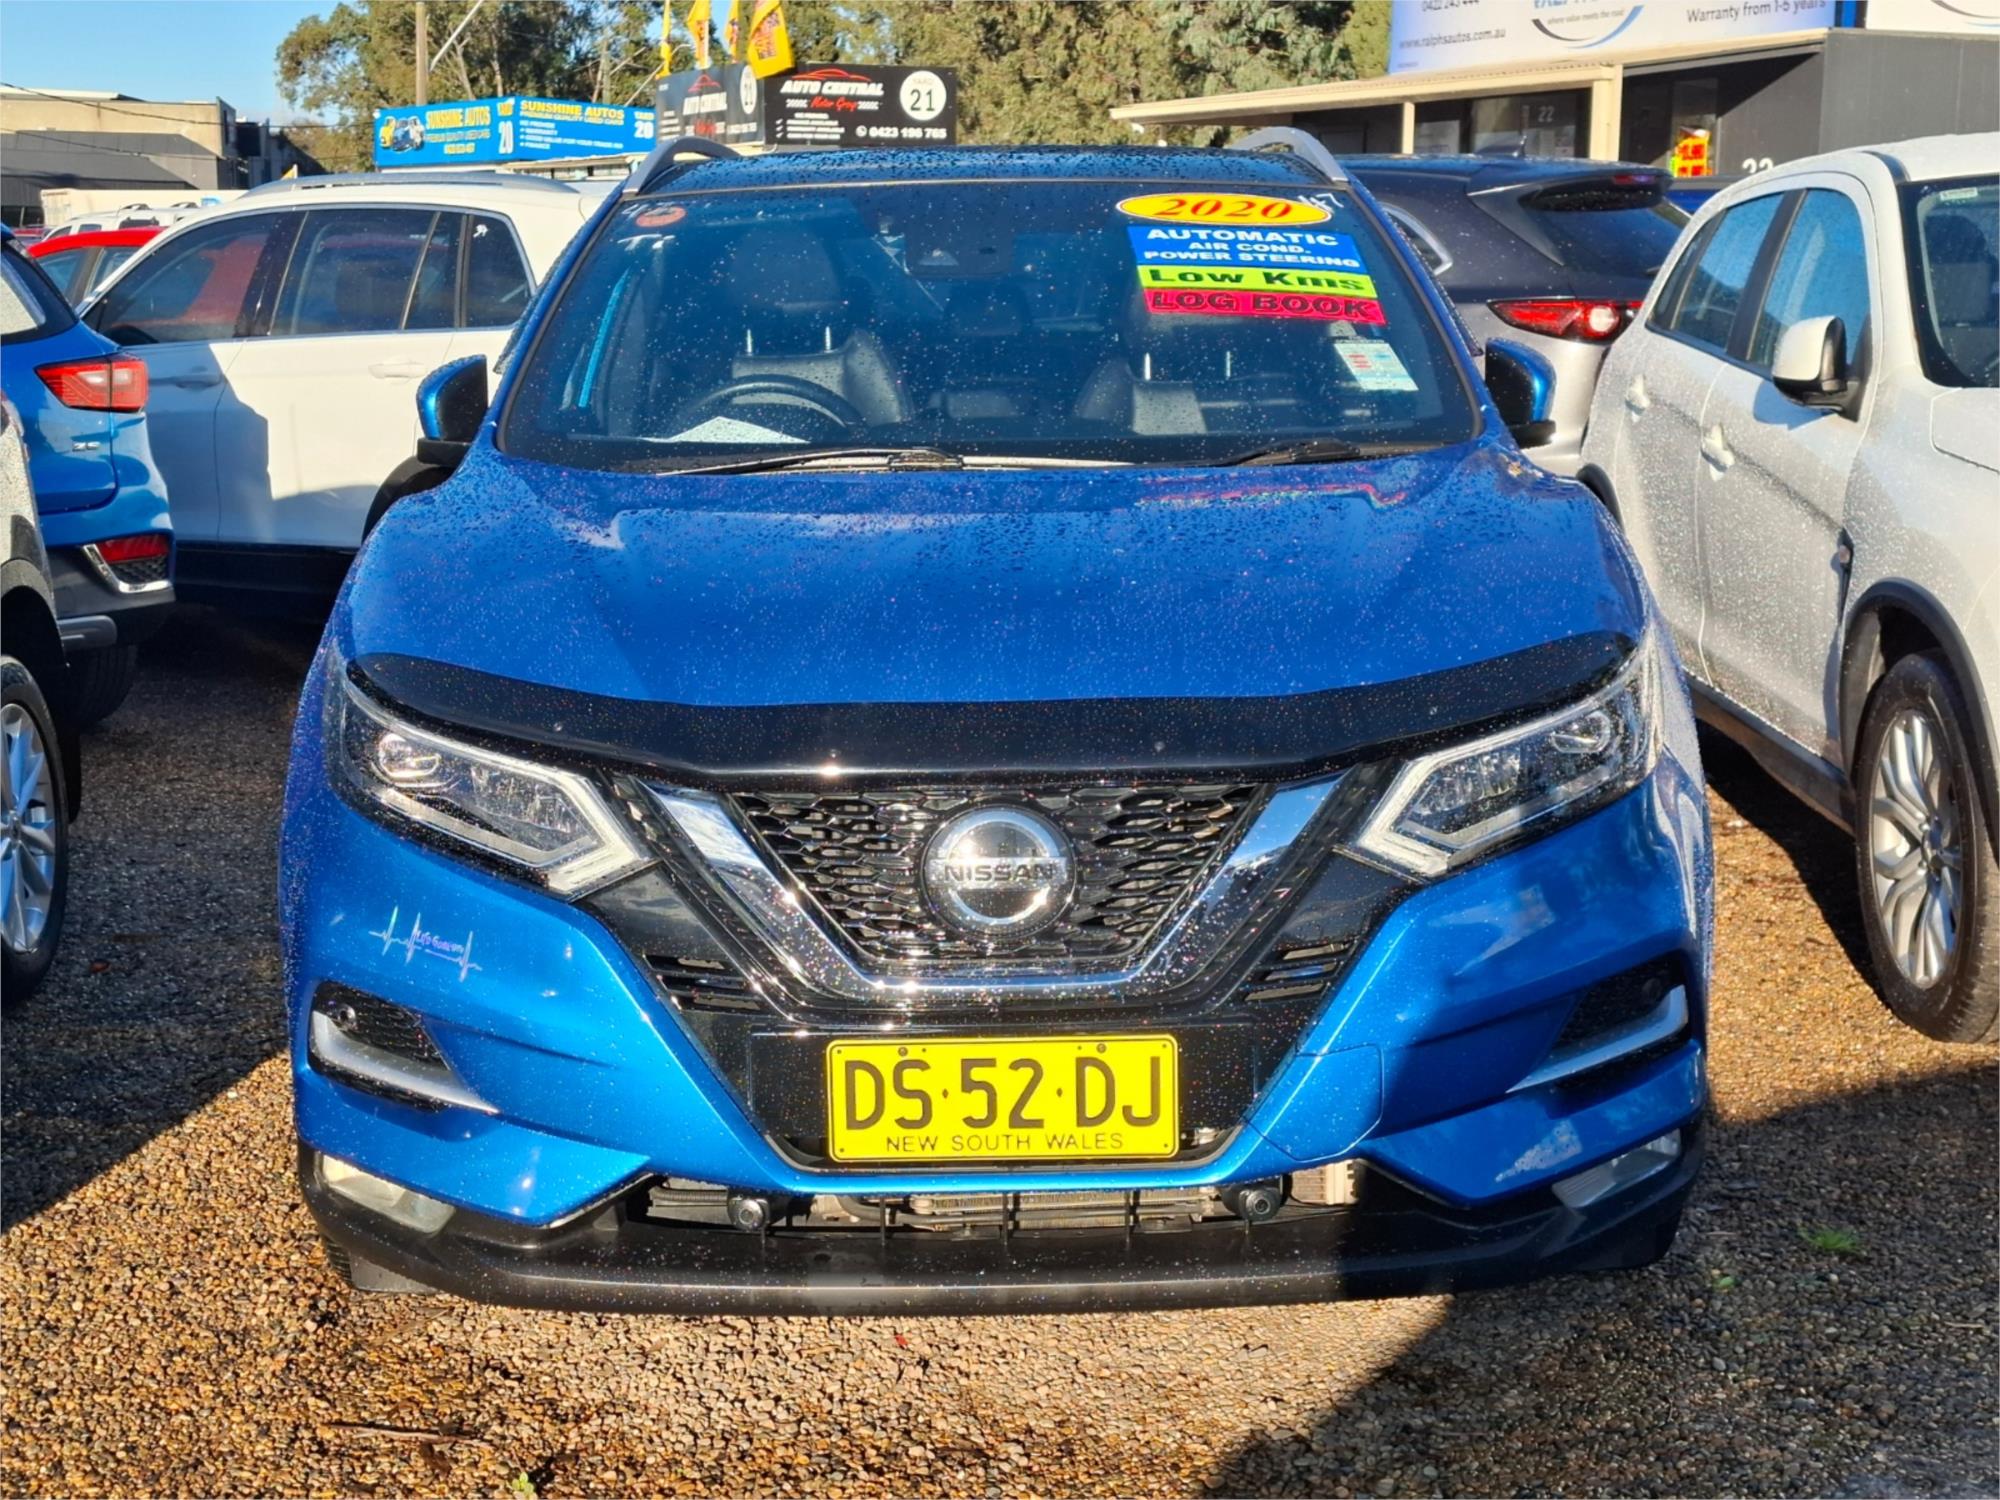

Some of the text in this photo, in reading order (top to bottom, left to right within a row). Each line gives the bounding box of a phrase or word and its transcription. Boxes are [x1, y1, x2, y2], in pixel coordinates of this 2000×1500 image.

[1687, 6, 1739, 22] Warranty
[1743, 1, 1771, 16] from
[1793, 0, 1826, 14] years
[780, 79, 884, 96] AUTO CENTRAL
[910, 88, 935, 112] 21
[520, 100, 583, 117] SUNSHINE
[585, 106, 625, 120] AUTOS
[1537, 105, 1555, 123] 22
[633, 121, 655, 139] 20
[868, 126, 899, 139] 0423
[1153, 198, 1294, 219] 2020
[1146, 228, 1340, 247] AUTOMATIC
[1189, 241, 1312, 255] AIR COND.
[1144, 251, 1361, 268] POWER STEERING
[1262, 271, 1366, 291] Kms
[1152, 291, 1373, 318] LOG BOOK
[944, 863, 1054, 882] NISSAN
[886, 1132, 1124, 1153] NEW SOUTH WALES
